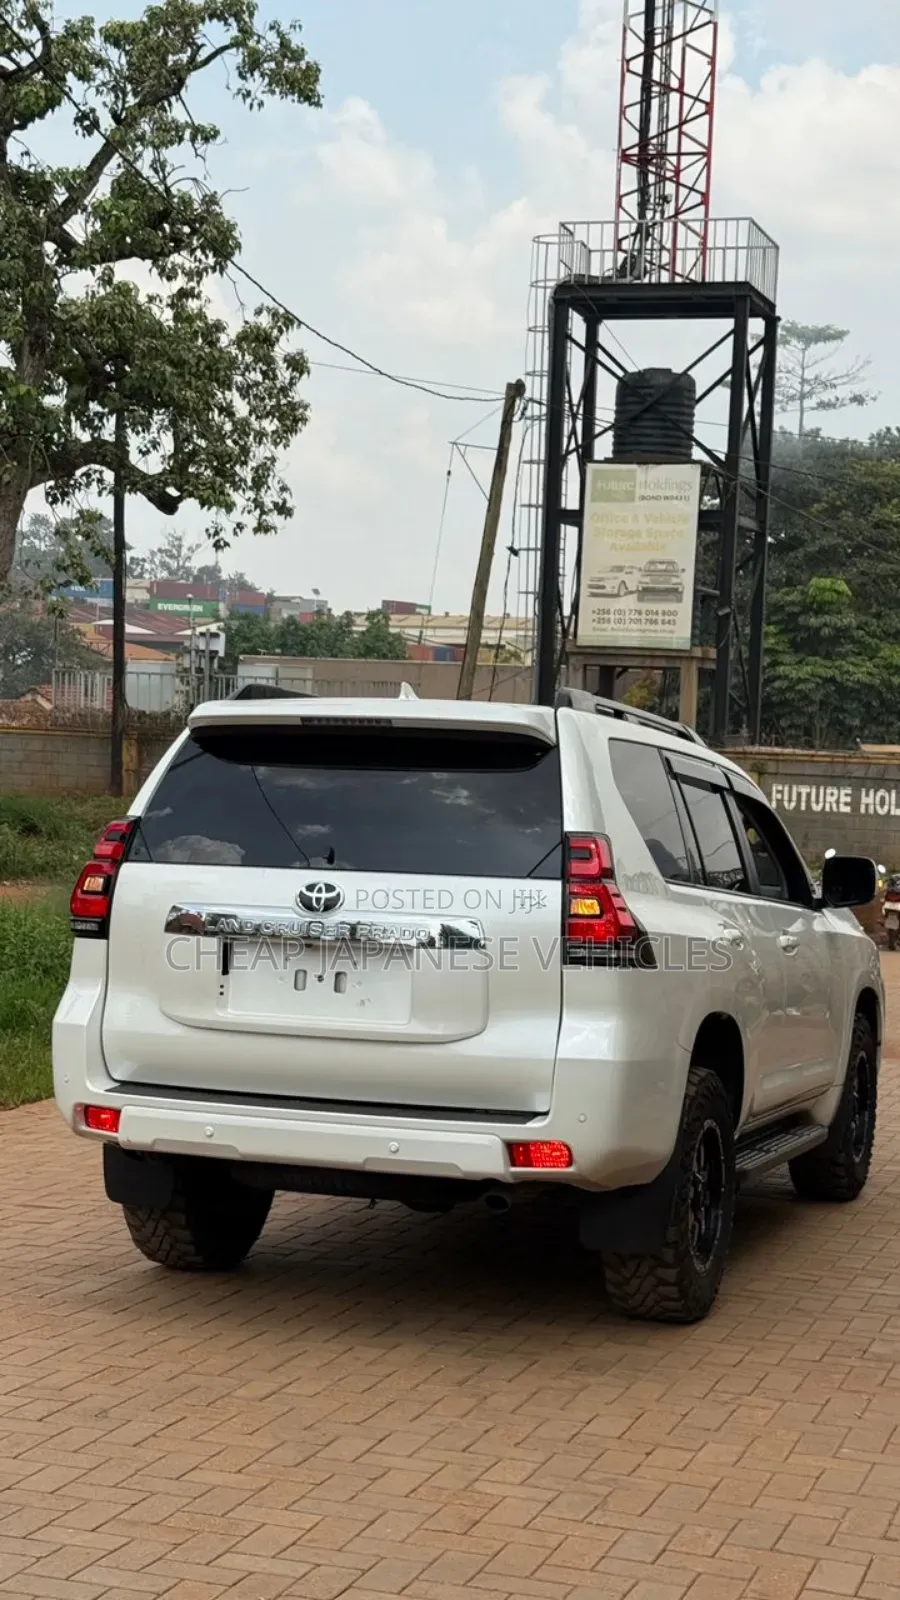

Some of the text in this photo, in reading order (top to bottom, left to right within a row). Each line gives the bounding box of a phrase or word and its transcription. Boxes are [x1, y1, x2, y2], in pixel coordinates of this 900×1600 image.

[639, 476, 693, 494] Holdings
[592, 608, 611, 616] +256
[613, 608, 626, 617] (0)
[592, 617, 611, 625] +256
[613, 617, 626, 626] (0)
[771, 783, 900, 816] FUTURE HOL
[204, 917, 431, 941] LAND CRUISER PRADO
